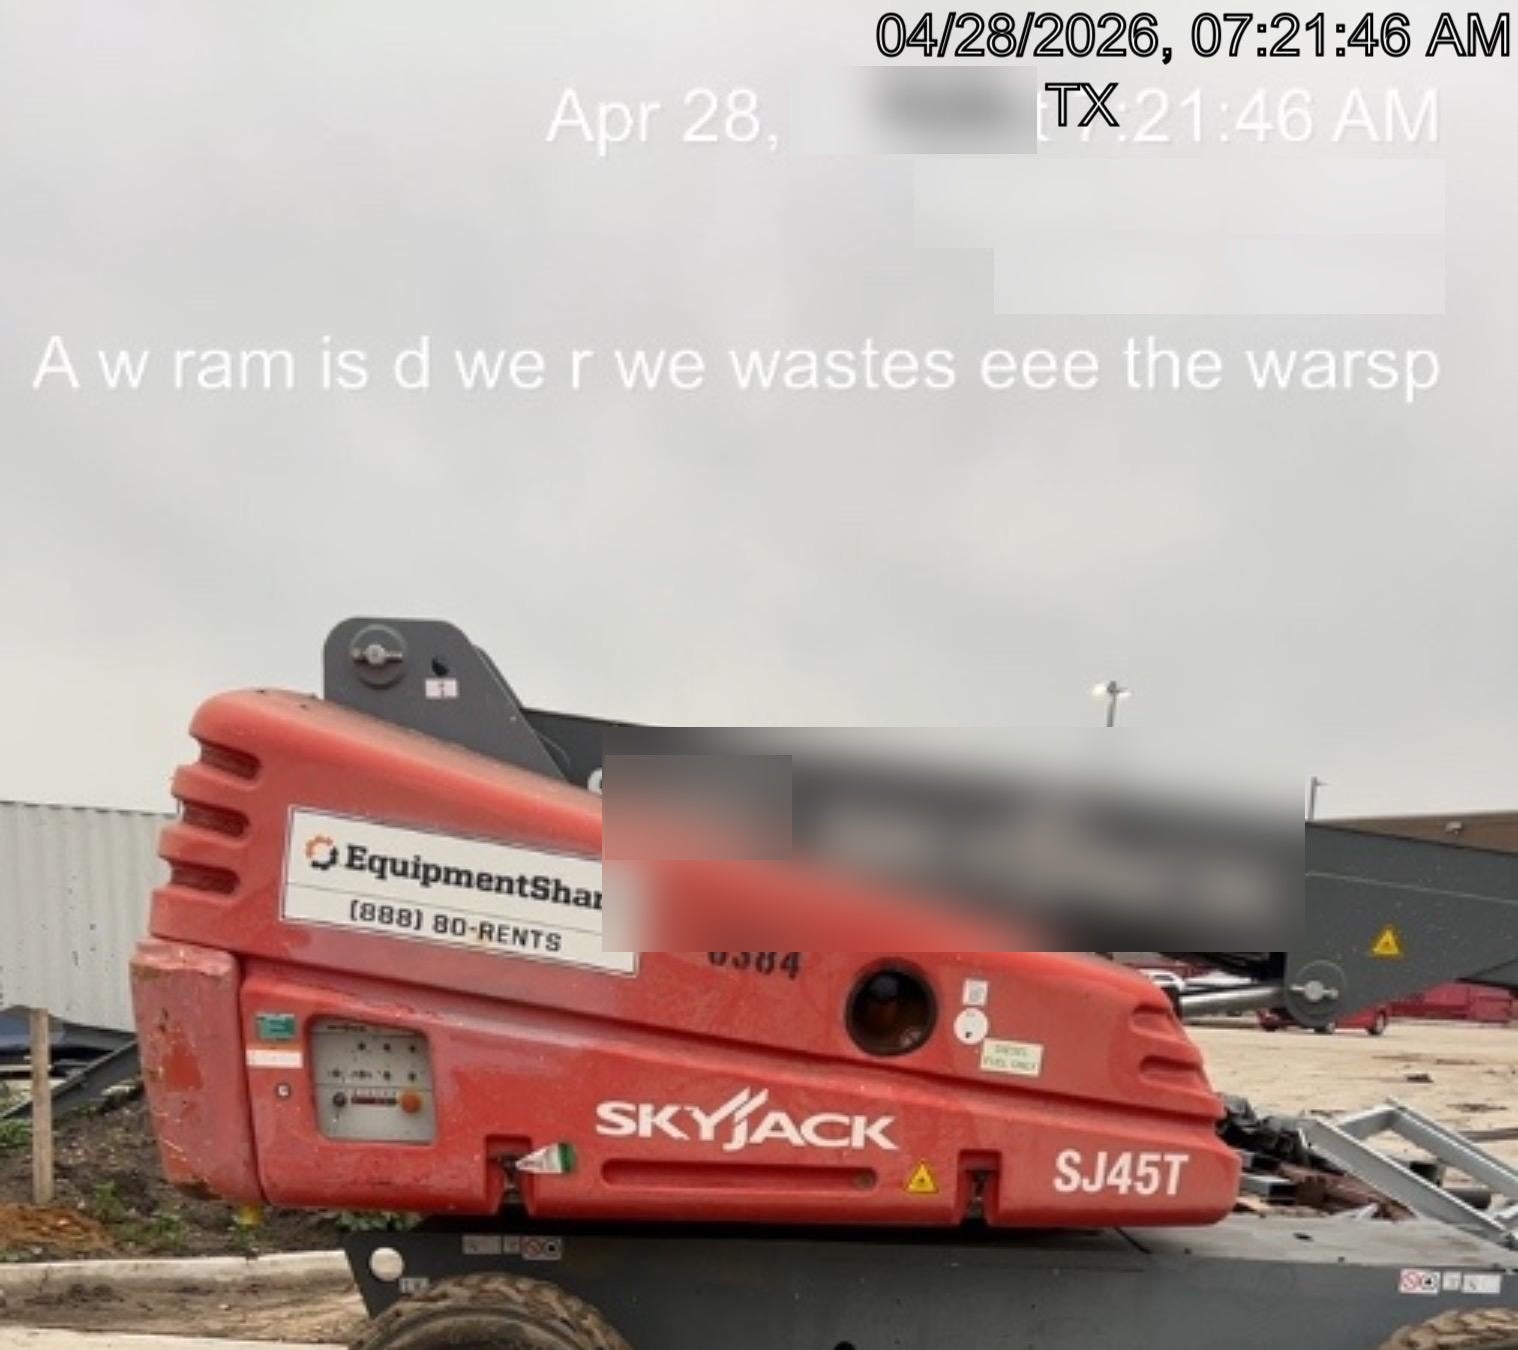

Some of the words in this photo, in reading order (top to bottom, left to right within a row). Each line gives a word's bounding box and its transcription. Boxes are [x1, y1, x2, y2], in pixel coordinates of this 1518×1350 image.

[349, 899, 424, 931] (888)
[596, 1088, 898, 1151] SKYJACK
[1053, 1149, 1190, 1196] SJ45T
